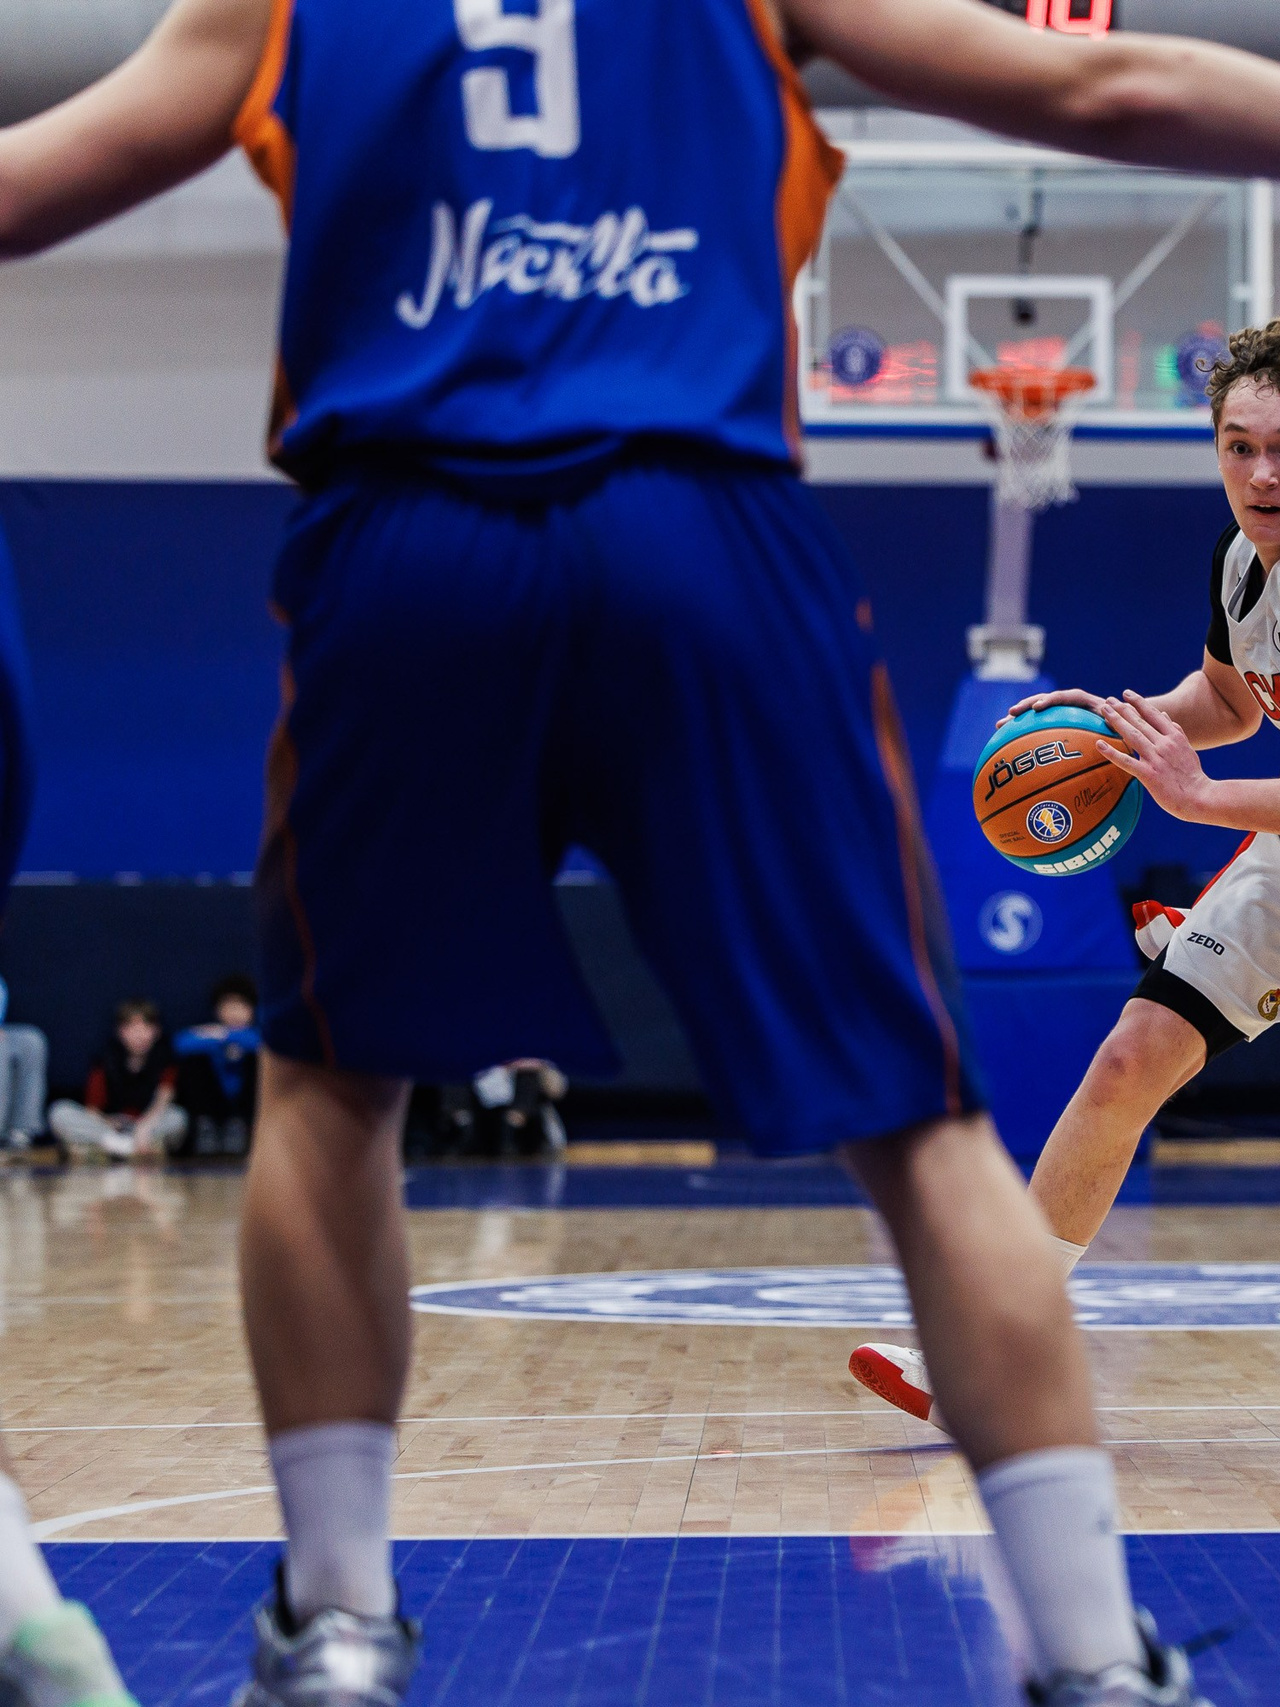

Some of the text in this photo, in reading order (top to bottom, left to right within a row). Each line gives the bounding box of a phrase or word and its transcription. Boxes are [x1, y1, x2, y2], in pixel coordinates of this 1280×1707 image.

[453, 0, 581, 158] 9
[985, 740, 1083, 802] JÖGEL
[1033, 825, 1121, 874] SIBUR
[1187, 932, 1225, 956] ZEDO
